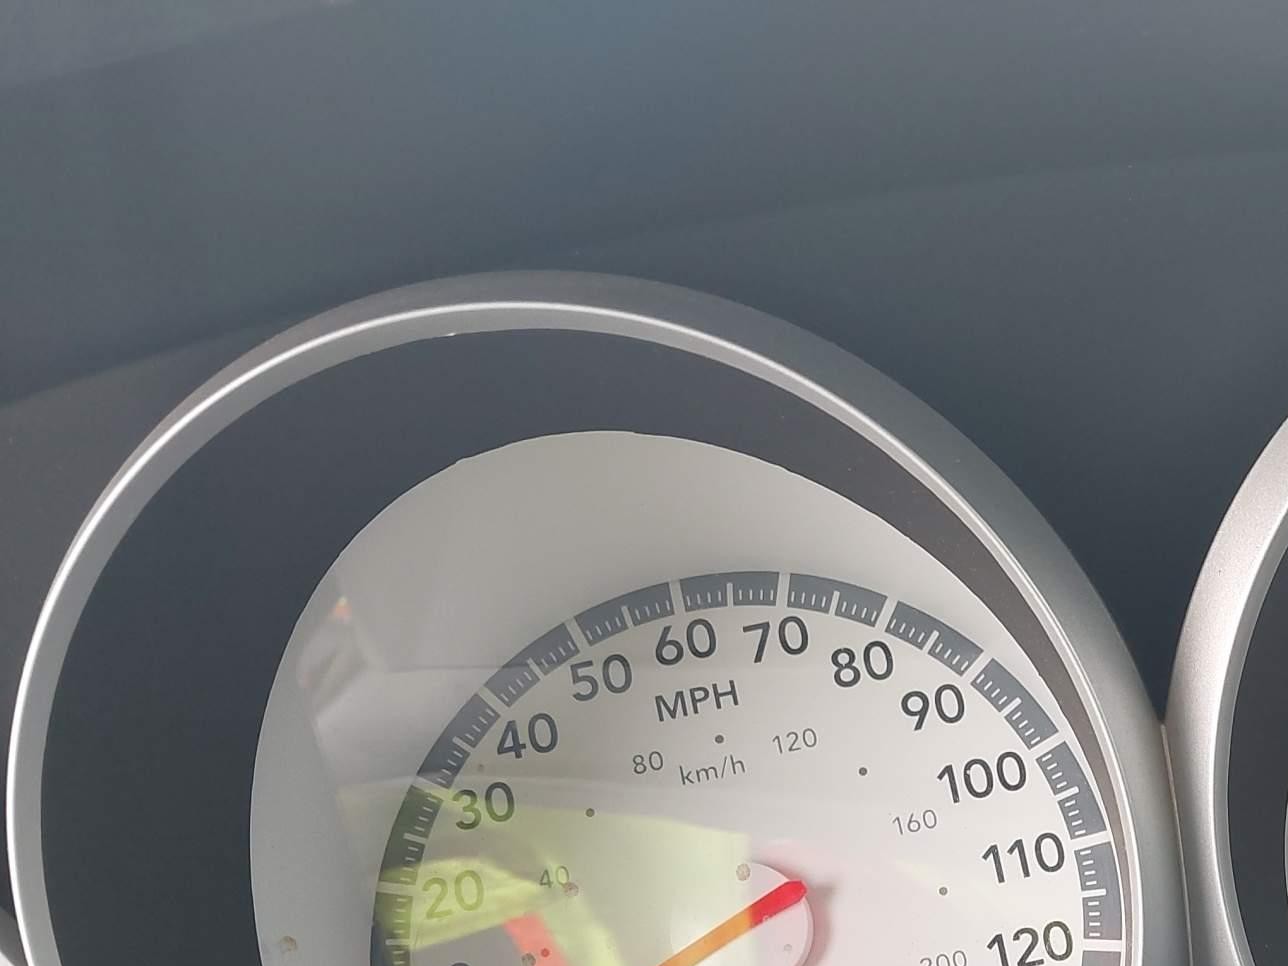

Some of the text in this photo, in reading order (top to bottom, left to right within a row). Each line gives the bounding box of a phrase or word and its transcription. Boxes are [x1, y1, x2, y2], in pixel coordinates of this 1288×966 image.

[655, 618, 717, 666] 60
[743, 616, 809, 663] 70
[570, 654, 633, 701] 50
[831, 640, 894, 688] 80
[654, 680, 740, 722] MPH
[901, 684, 965, 731] 90
[496, 712, 559, 759] 40
[772, 728, 818, 754] 120
[632, 751, 664, 775] 80
[679, 754, 745, 785] km/h
[937, 751, 1027, 803] 100
[452, 782, 515, 830] 30
[892, 809, 938, 836] 160
[539, 865, 570, 889] 40
[981, 832, 1065, 884] 110
[422, 869, 484, 920] 20
